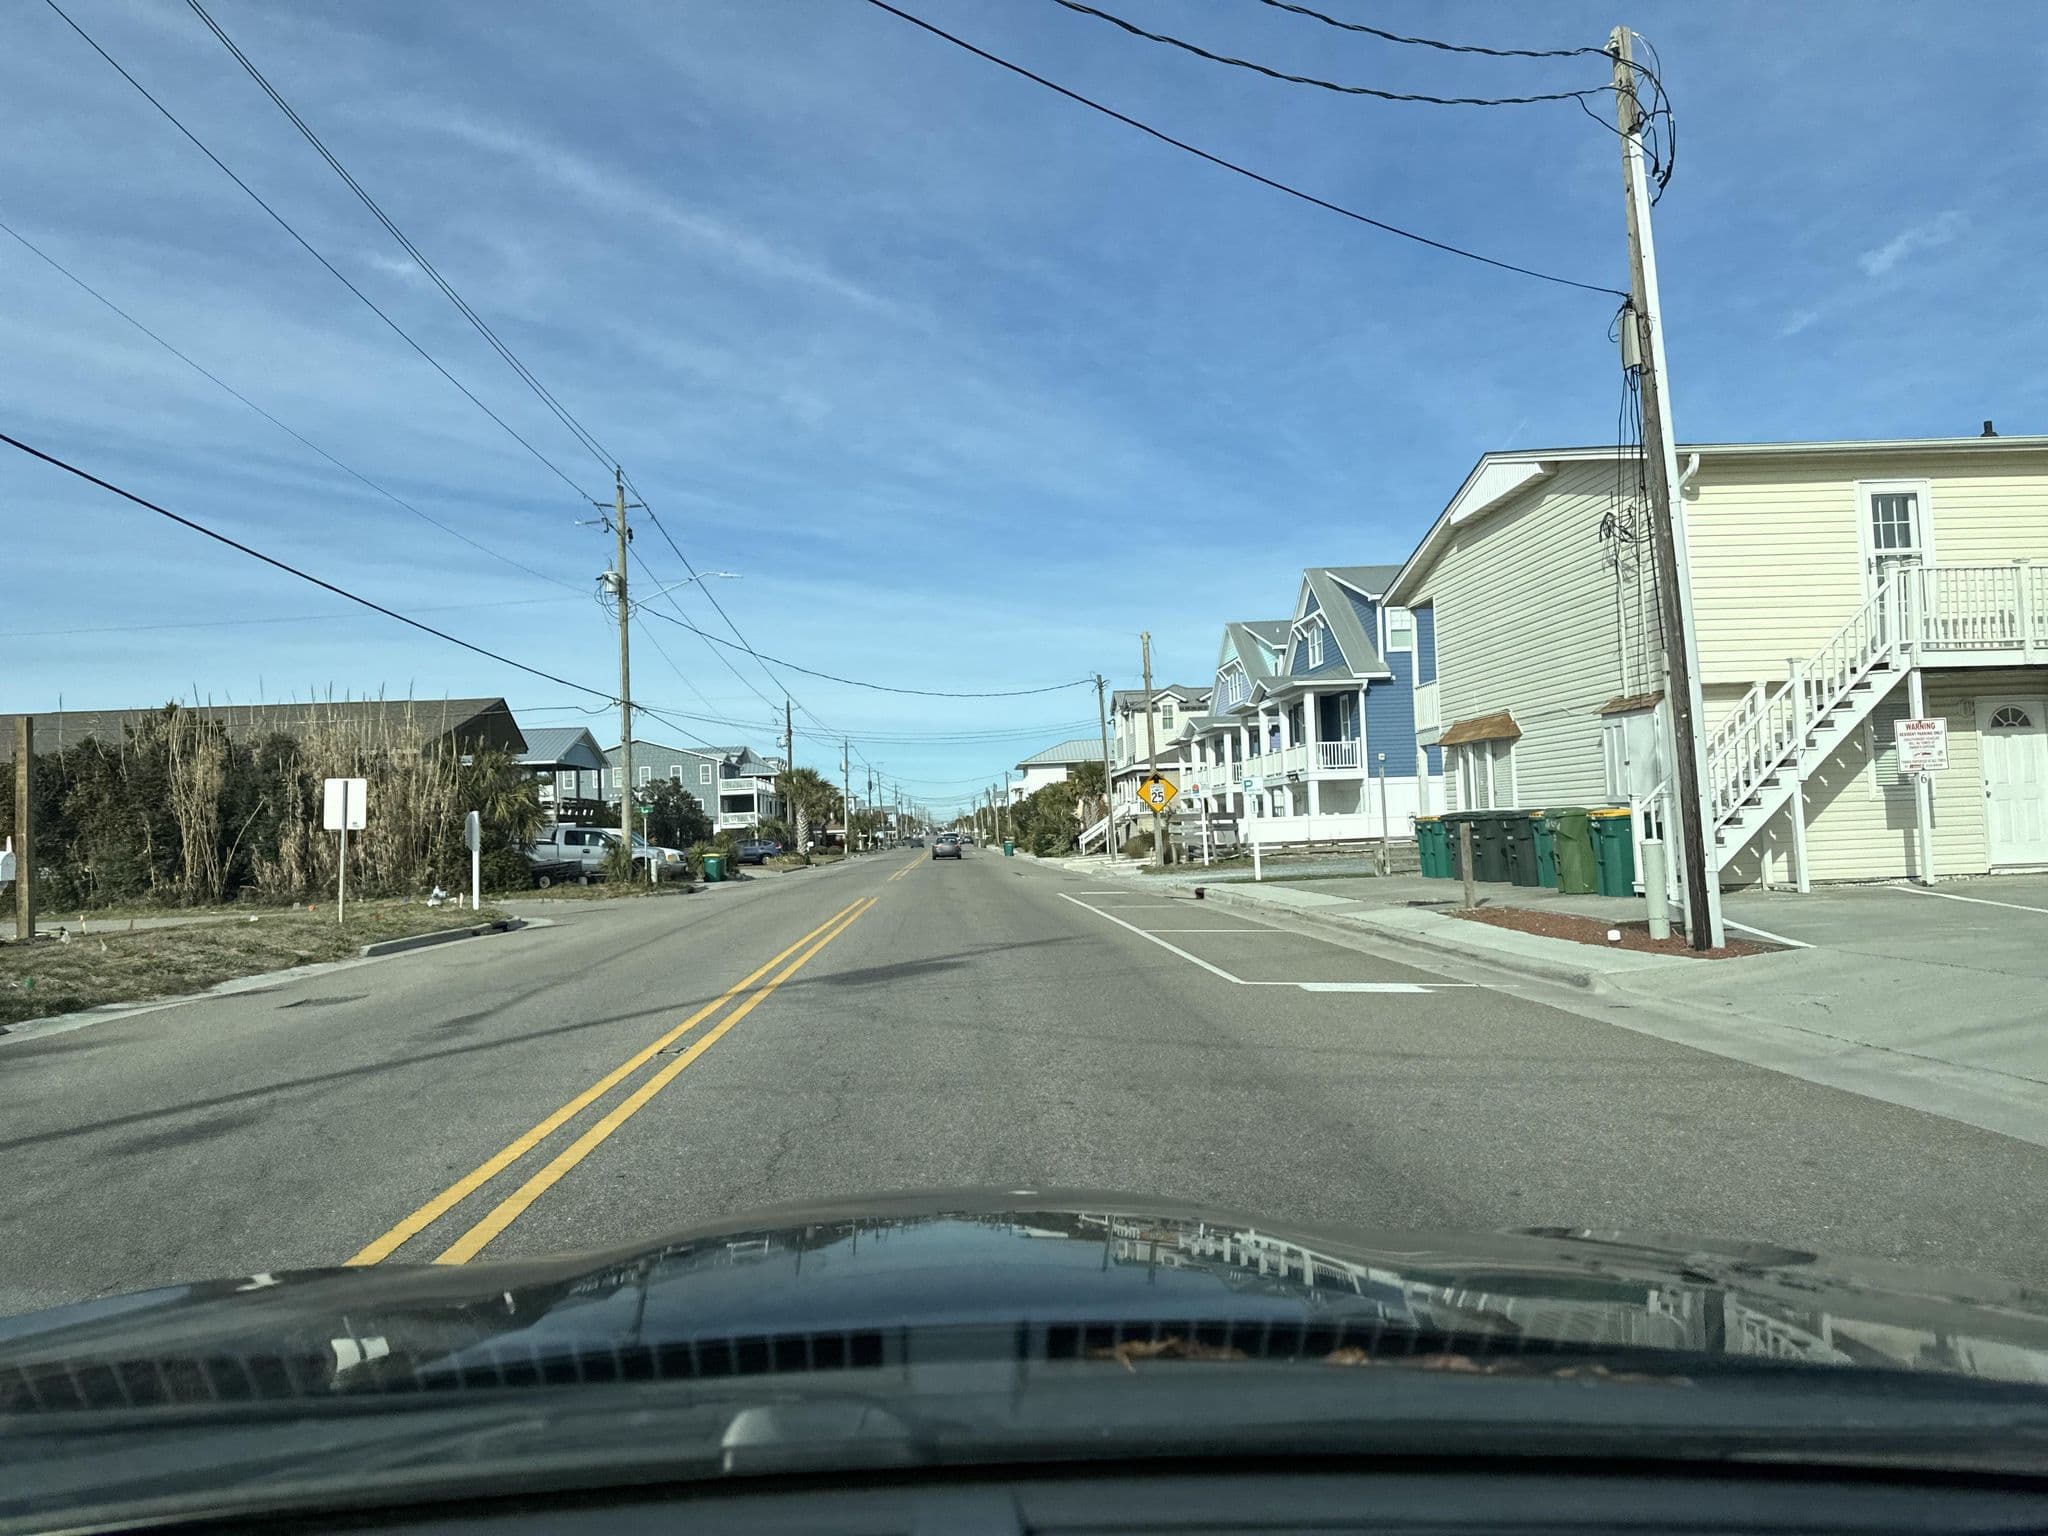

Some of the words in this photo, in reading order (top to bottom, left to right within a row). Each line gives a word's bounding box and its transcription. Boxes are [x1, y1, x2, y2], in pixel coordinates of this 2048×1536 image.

[1905, 722, 1936, 731] WARNING
[1920, 773, 1928, 784] 6
[1243, 779, 1253, 792] P
[1151, 791, 1164, 803] 25
